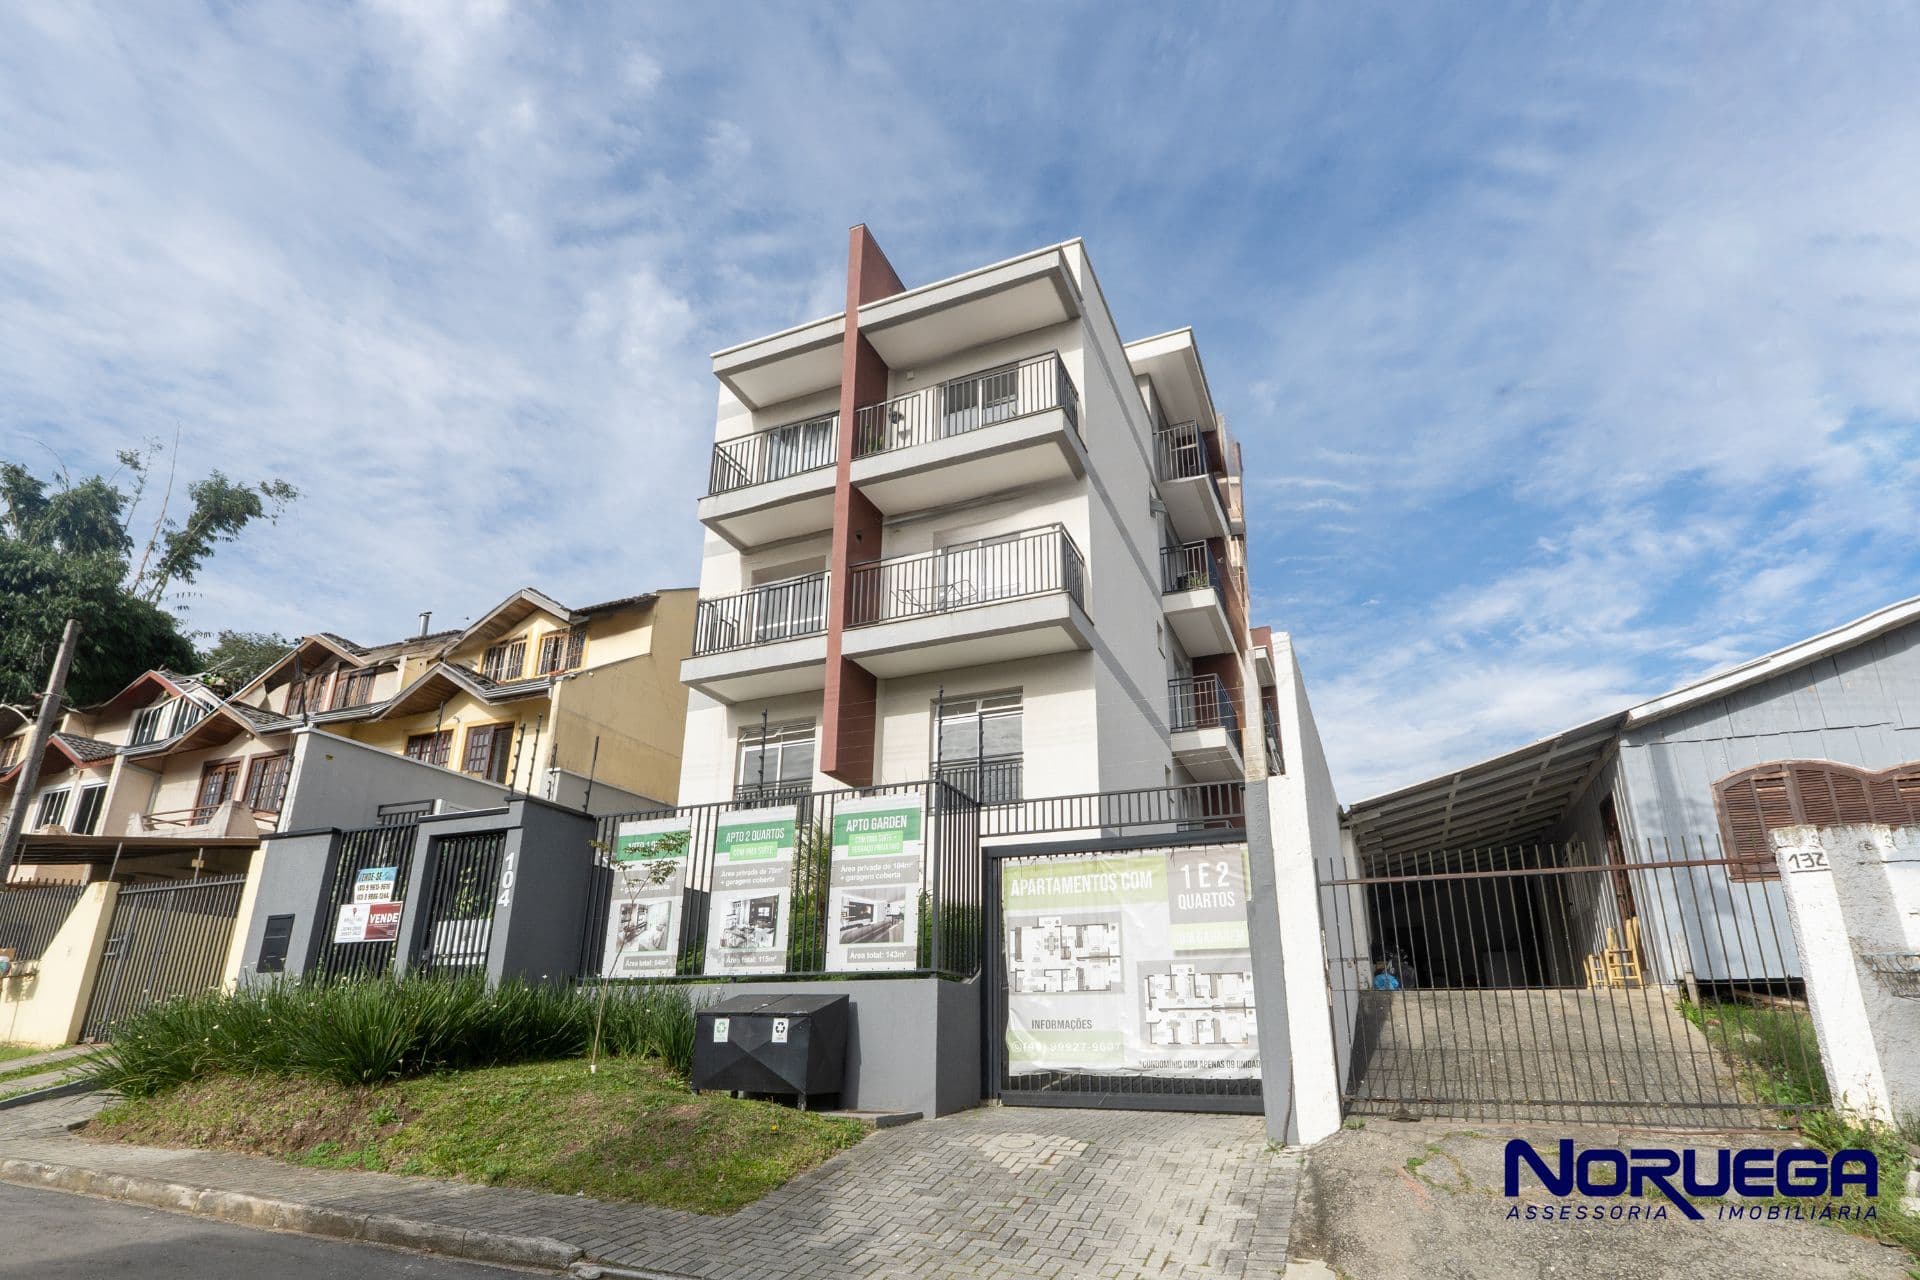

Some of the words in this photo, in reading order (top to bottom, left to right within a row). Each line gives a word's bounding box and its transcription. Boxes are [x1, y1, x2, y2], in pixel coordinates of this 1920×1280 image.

[846, 819, 869, 832] APTO
[871, 815, 908, 830] GARDEN
[726, 832, 744, 843] APTO
[745, 831, 750, 841] 2
[752, 828, 784, 840] QUARTOS
[858, 863, 881, 872] privada
[1789, 852, 1828, 868] 132
[498, 852, 515, 907] 104
[875, 872, 900, 880] coberta
[1182, 867, 1191, 889] 1
[1199, 864, 1210, 887] E
[1217, 862, 1230, 887] 2
[1010, 874, 1116, 897] APARTAMENTOS
[1121, 872, 1152, 889] COM
[1178, 891, 1235, 909] QUARTOS
[369, 912, 399, 924] VENDE
[1031, 1018, 1092, 1031] INFORMAÇÕES
[1183, 1060, 1198, 1068] COM
[1199, 1060, 1225, 1068] APENAS
